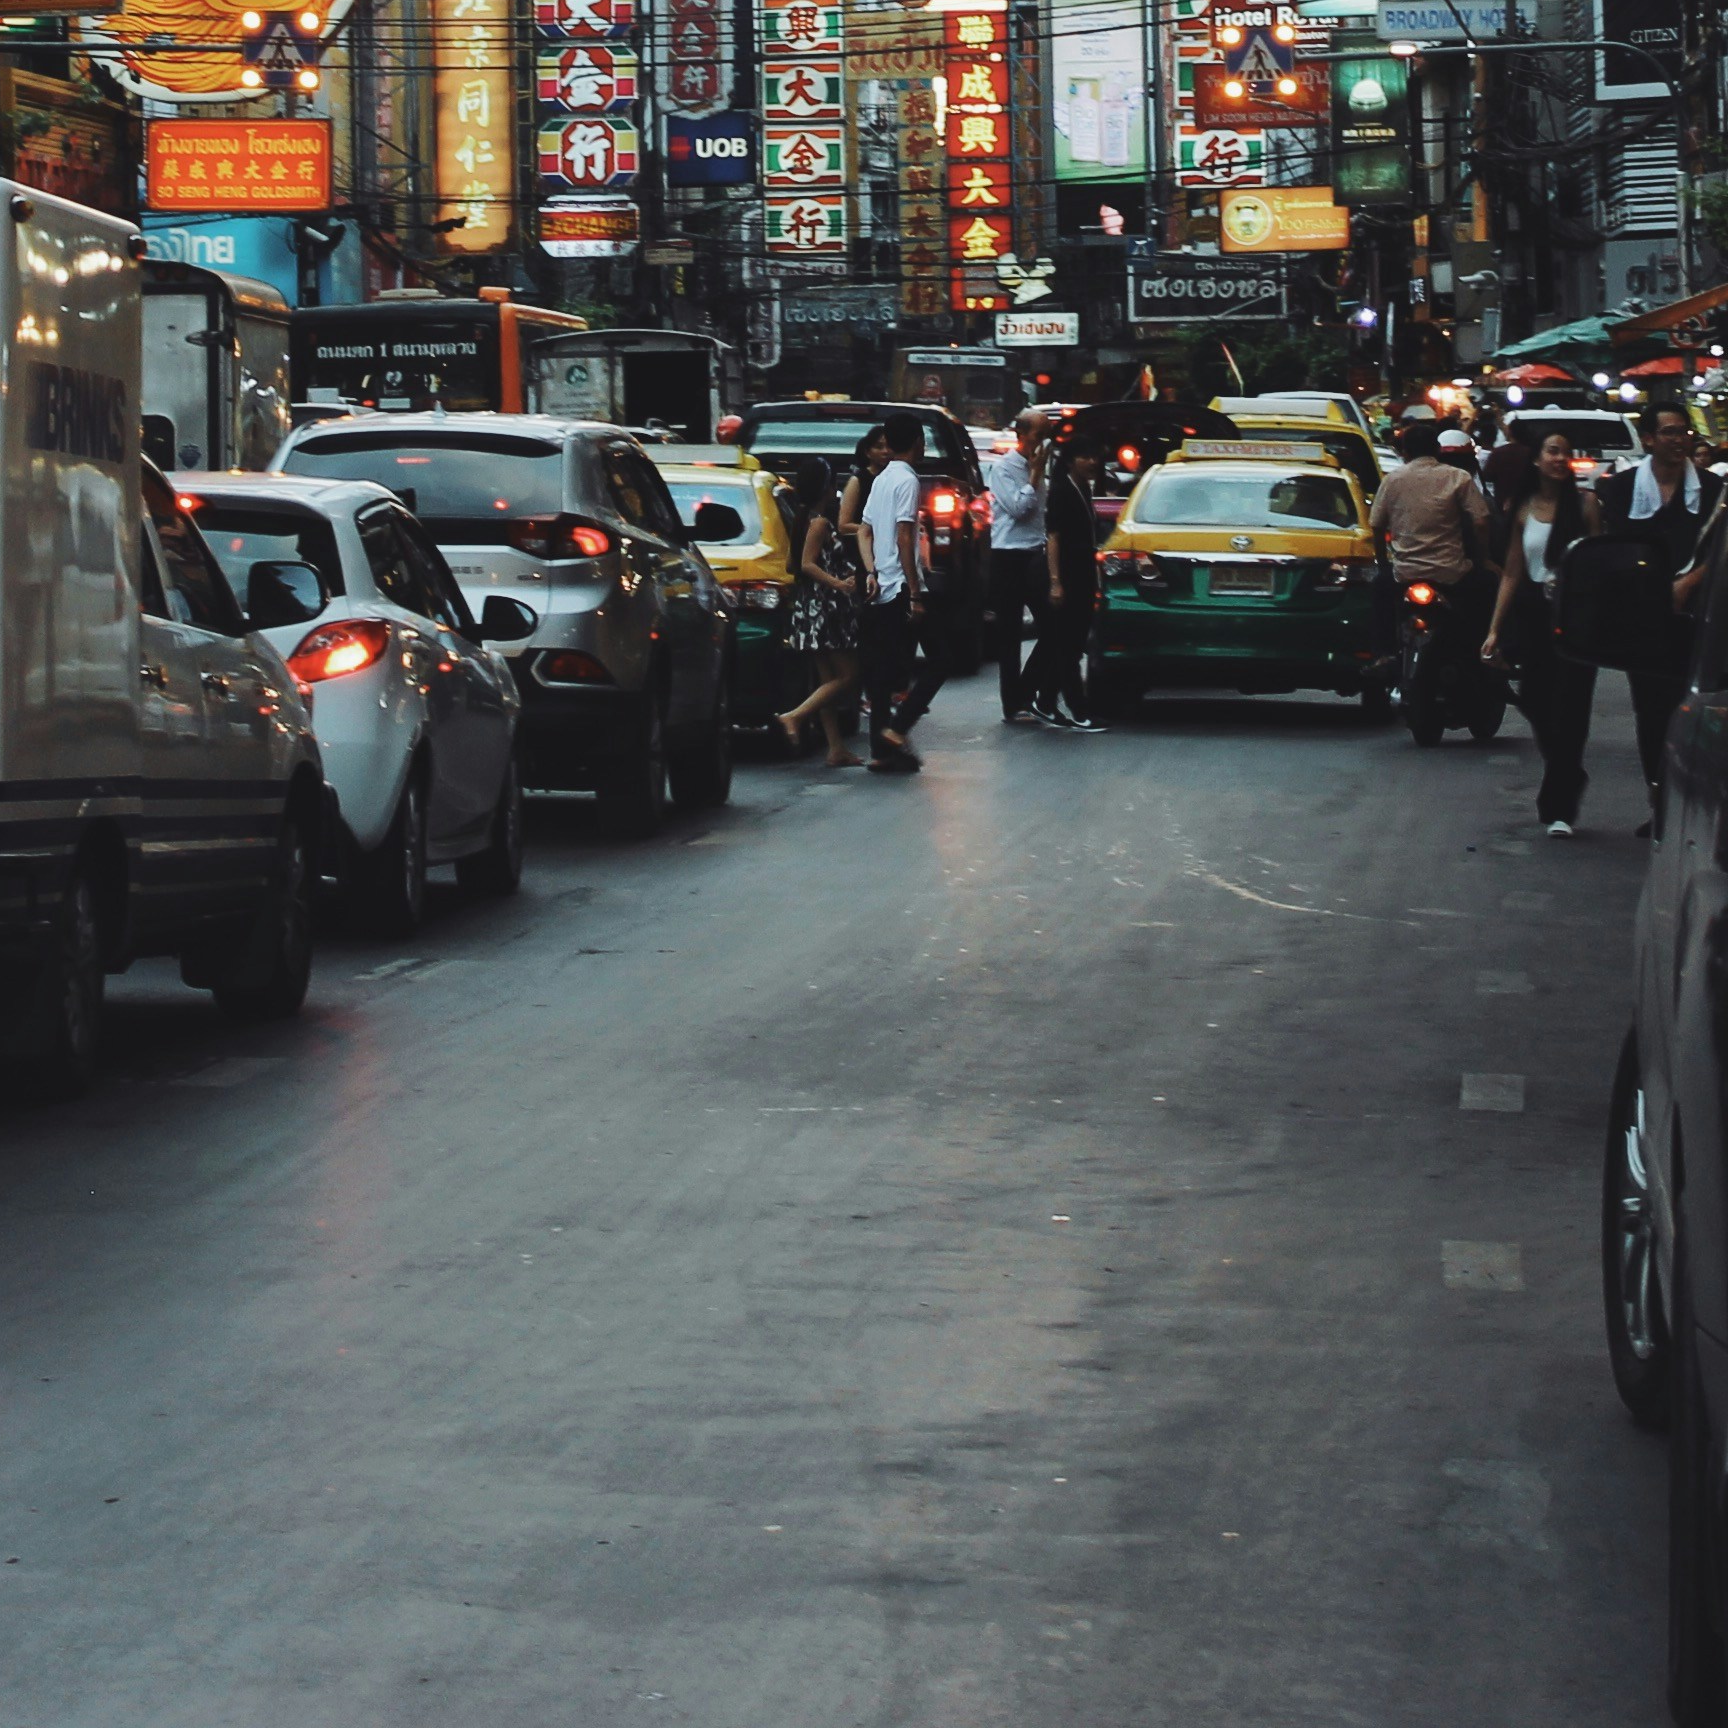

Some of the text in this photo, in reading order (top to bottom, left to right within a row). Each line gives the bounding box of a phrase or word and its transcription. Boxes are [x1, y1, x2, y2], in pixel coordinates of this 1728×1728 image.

[1385, 10, 1471, 30] BROADWAY
[696, 137, 748, 159] UOB
[157, 186, 321, 199] SO SENG HENG GOLDSMITH
[379, 342, 388, 358] 1
